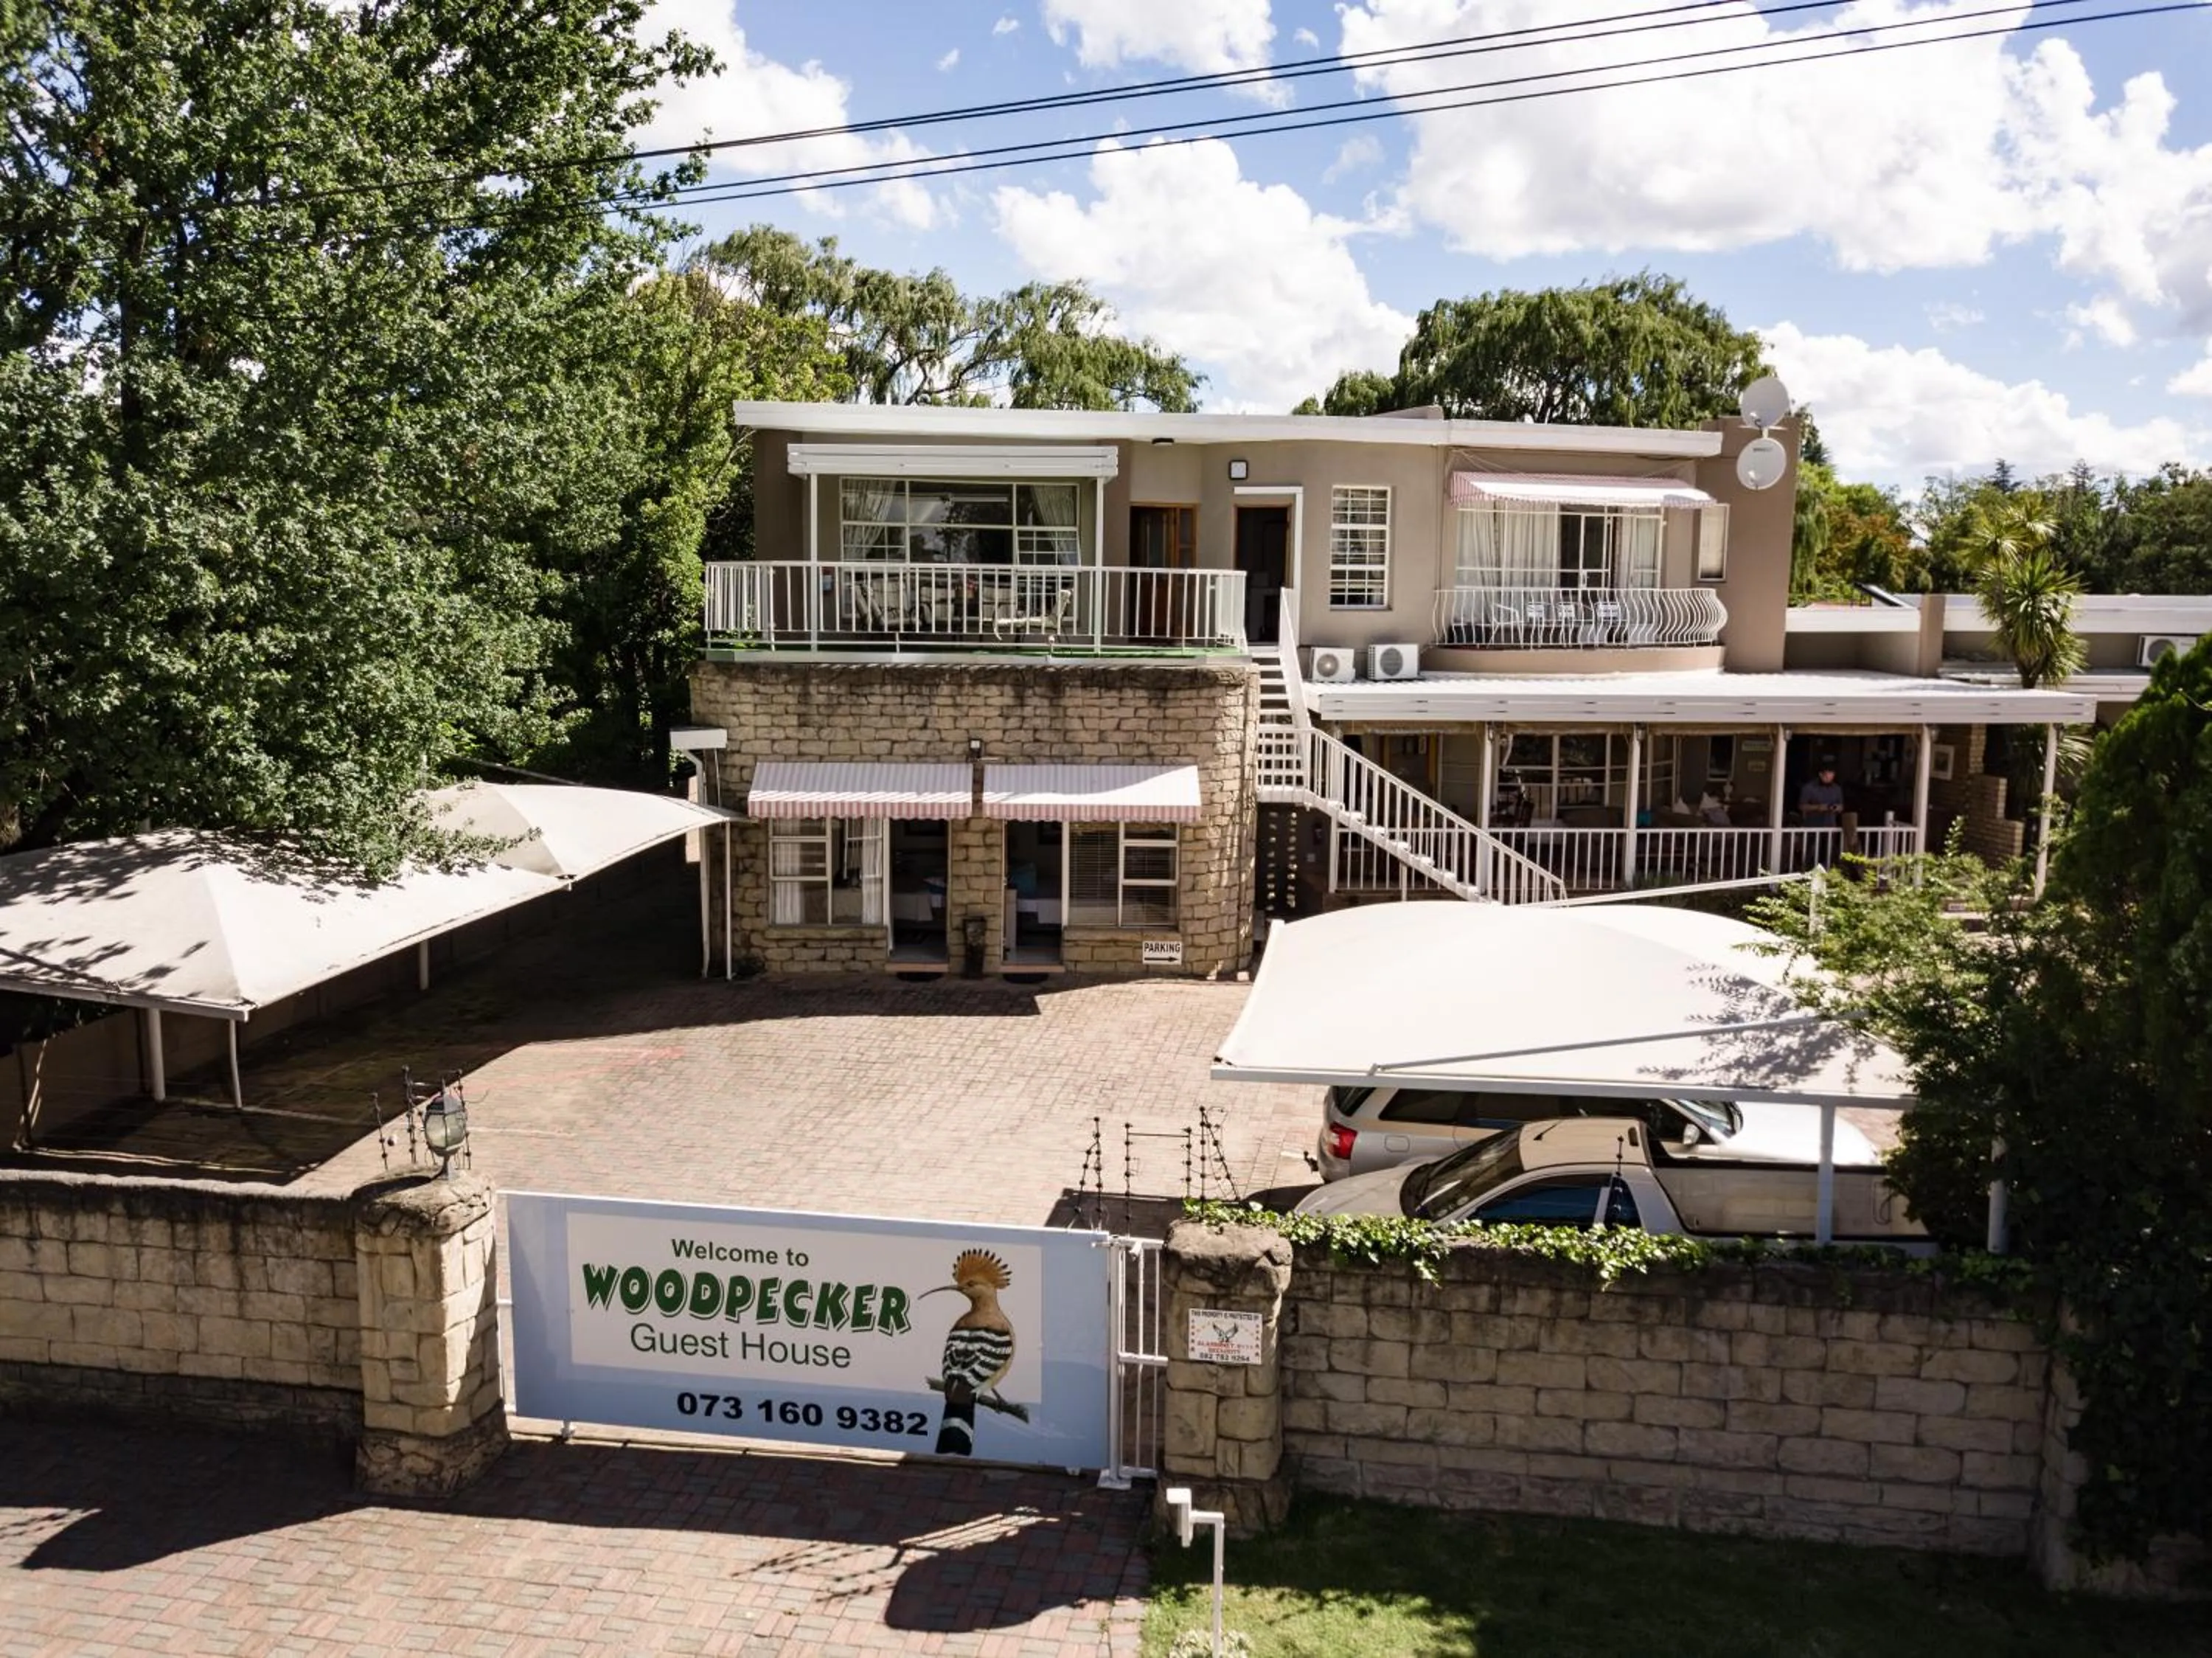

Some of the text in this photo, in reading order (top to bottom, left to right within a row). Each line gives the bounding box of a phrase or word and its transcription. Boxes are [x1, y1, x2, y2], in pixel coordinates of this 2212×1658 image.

[1144, 943, 1180, 953] PARKING
[671, 1238, 809, 1266] Welcome to
[582, 1263, 912, 1336] WOODPECKER
[630, 1322, 852, 1368] Guest House
[677, 1392, 929, 1437] 073 160 9382
